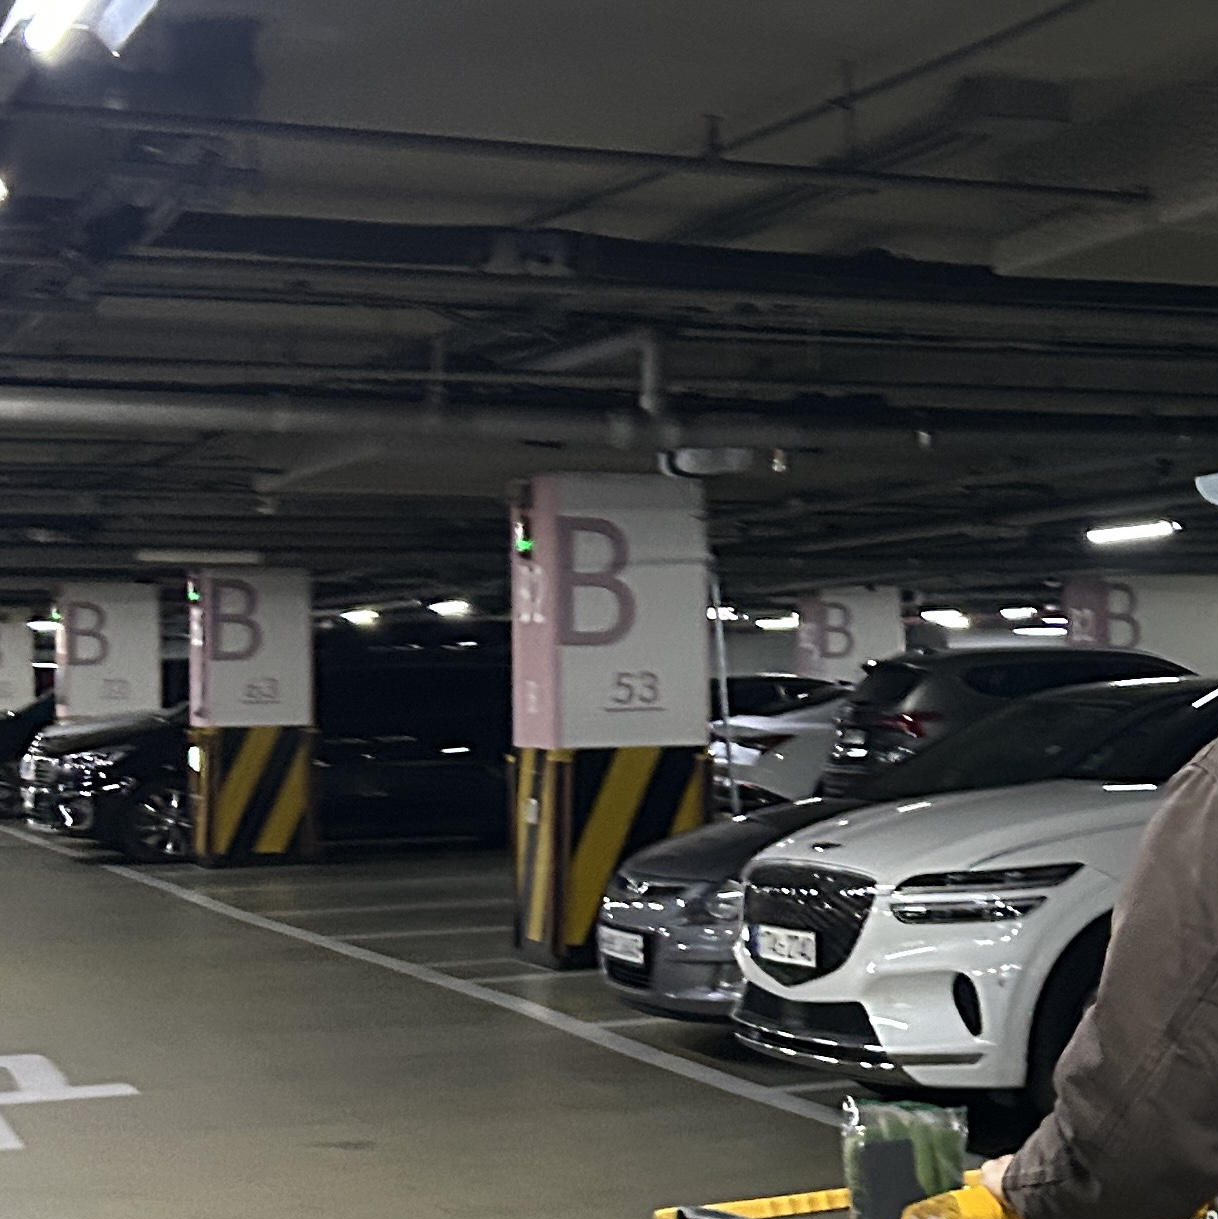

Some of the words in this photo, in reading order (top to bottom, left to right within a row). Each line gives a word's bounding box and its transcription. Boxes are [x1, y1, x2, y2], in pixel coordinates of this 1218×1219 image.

[556, 515, 636, 646] B
[68, 601, 110, 666] B
[210, 578, 263, 661] B
[819, 602, 854, 658] B
[612, 671, 660, 705] 53
